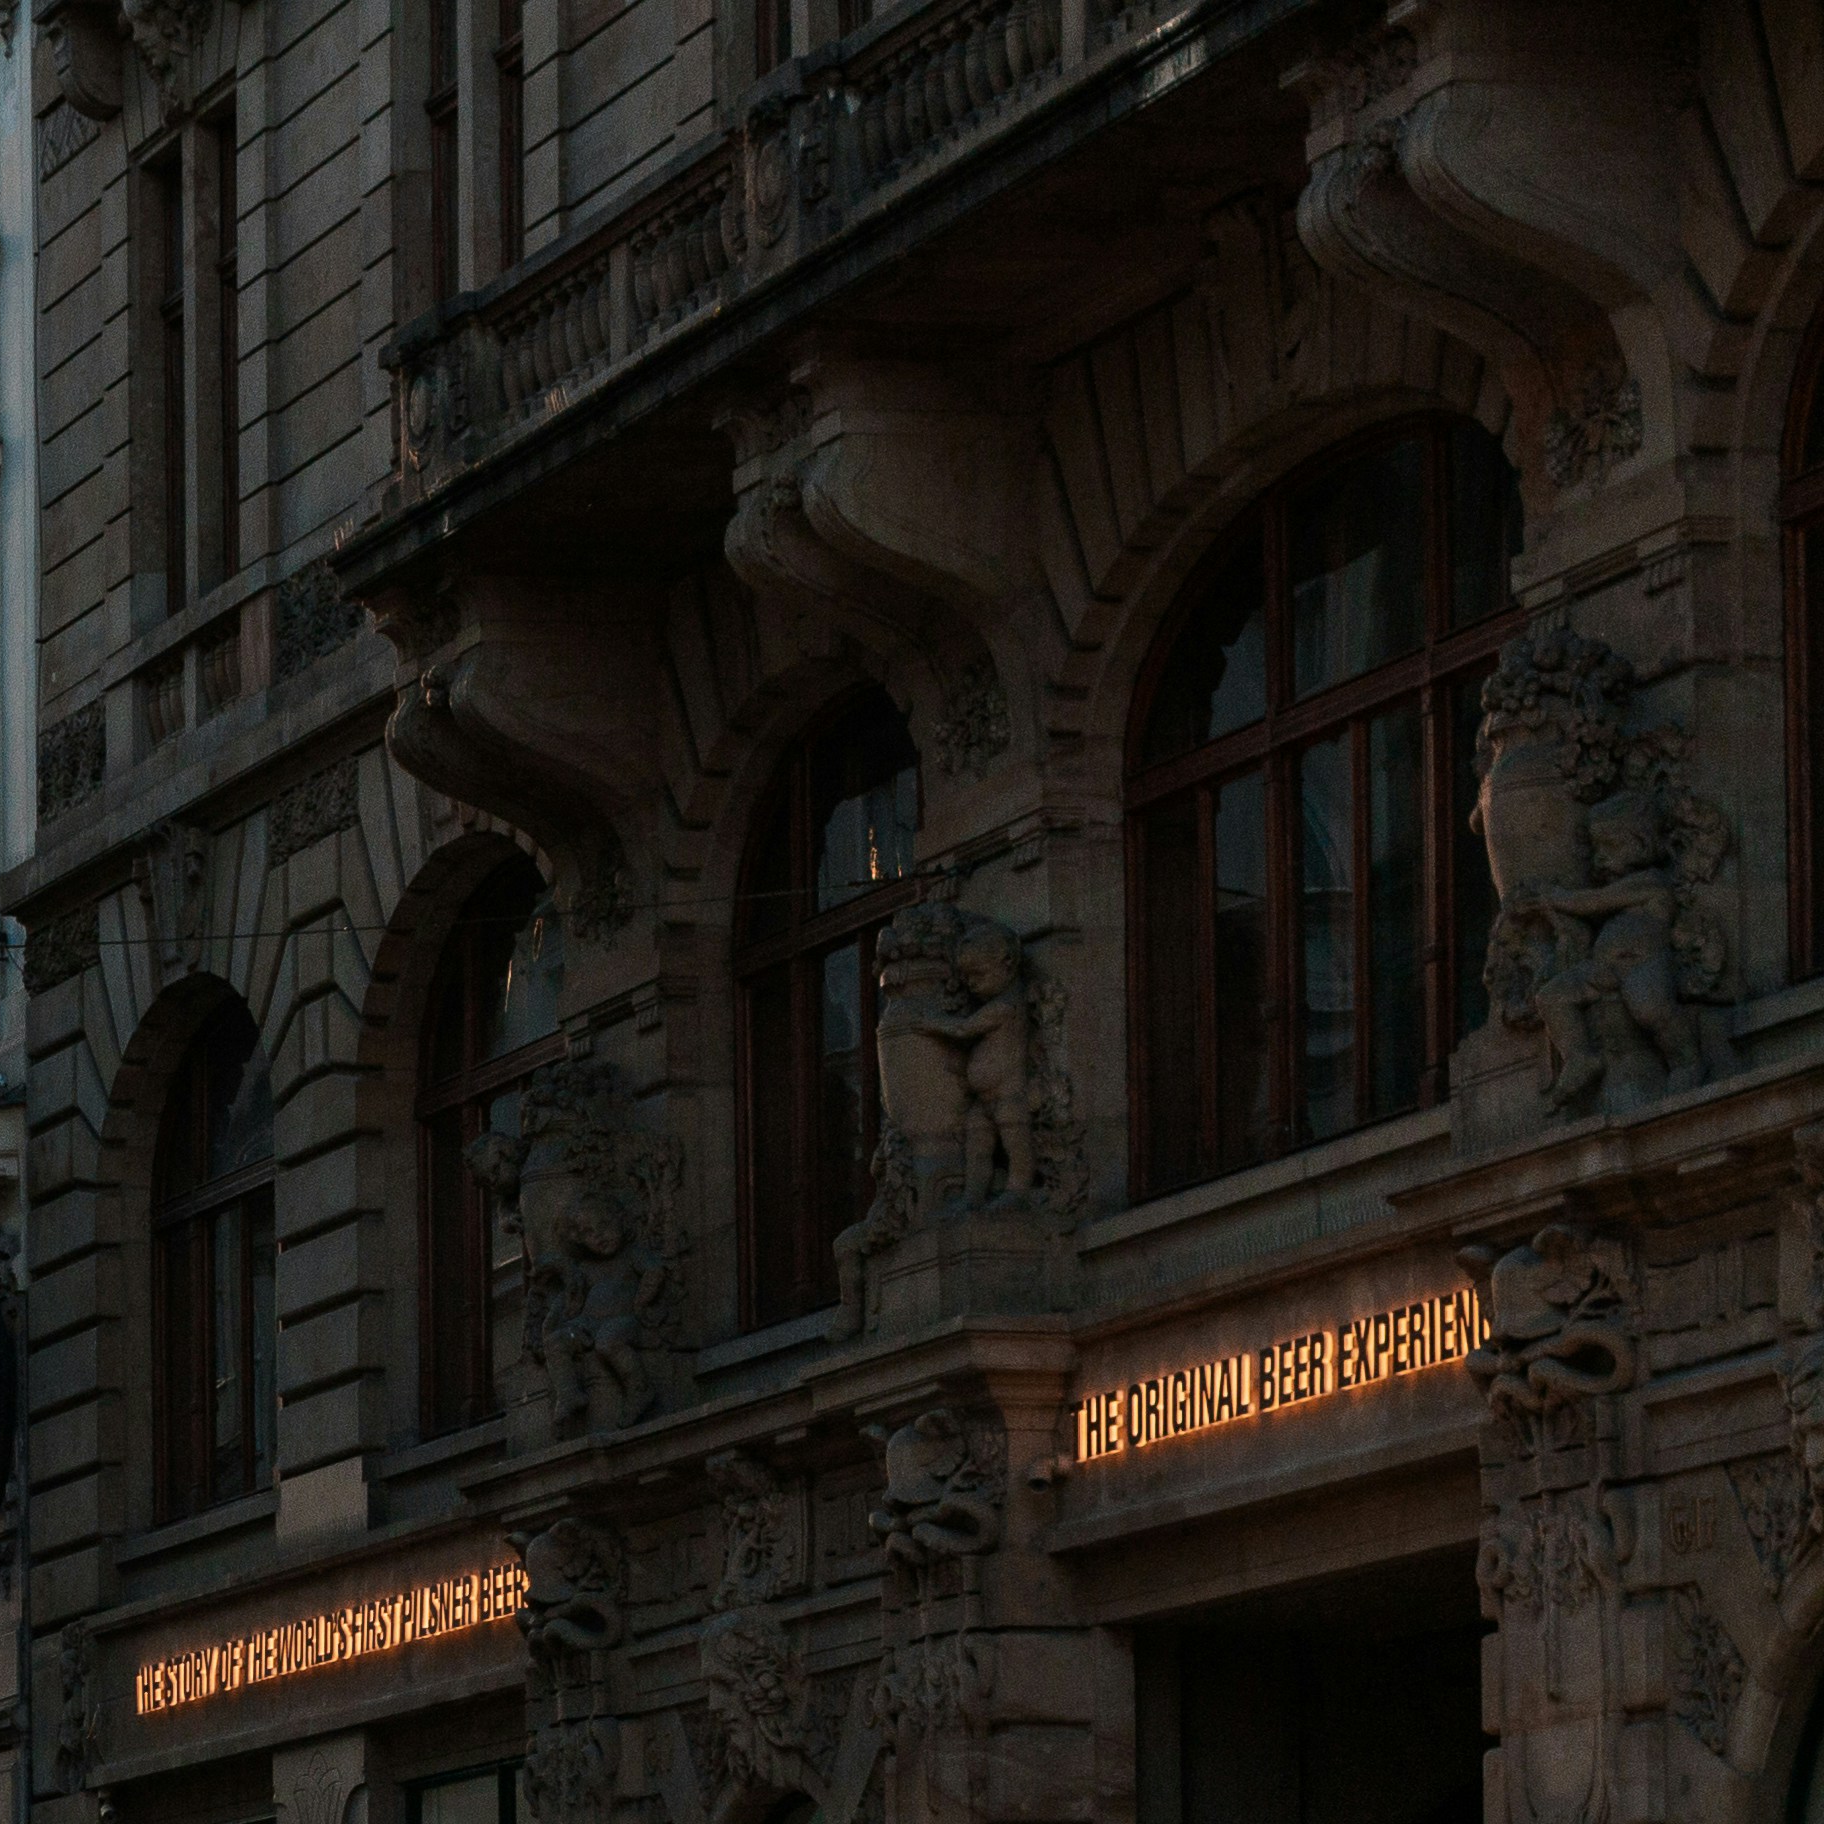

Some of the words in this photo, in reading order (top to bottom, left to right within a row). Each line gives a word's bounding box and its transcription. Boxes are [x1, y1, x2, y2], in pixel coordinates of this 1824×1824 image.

[1071, 1391, 1123, 1463] THE
[1128, 1354, 1255, 1447] ORIGINAL
[1260, 1331, 1332, 1412] BEER
[166, 1646, 220, 1706] STORY
[221, 1639, 243, 1691] OF
[245, 1628, 278, 1684] THE
[279, 1608, 352, 1676] WORLD'S
[353, 1594, 403, 1657] FIRST
[403, 1574, 479, 1643] PILSNER
